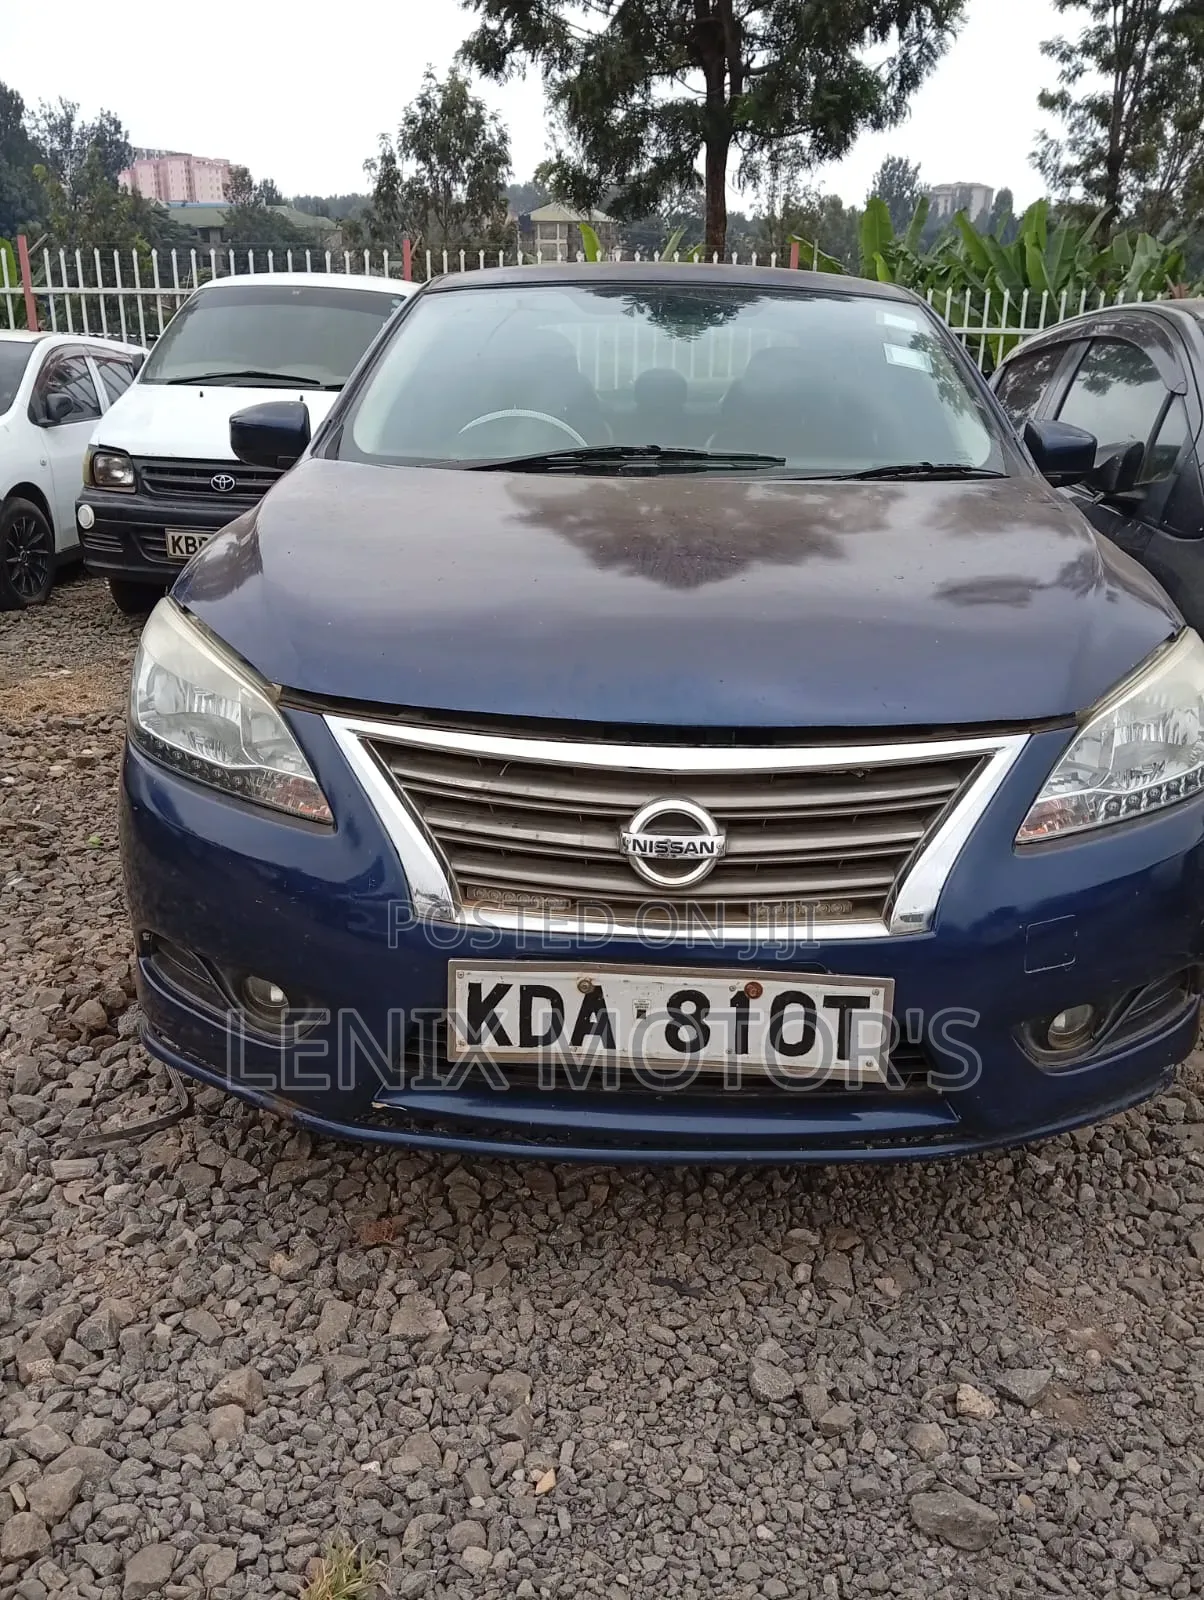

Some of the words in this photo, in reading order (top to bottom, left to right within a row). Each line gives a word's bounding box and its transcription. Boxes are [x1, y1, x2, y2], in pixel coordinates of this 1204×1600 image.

[632, 838, 715, 854] NISSAN
[466, 981, 617, 1051] KDA
[664, 989, 871, 1061] 810T
